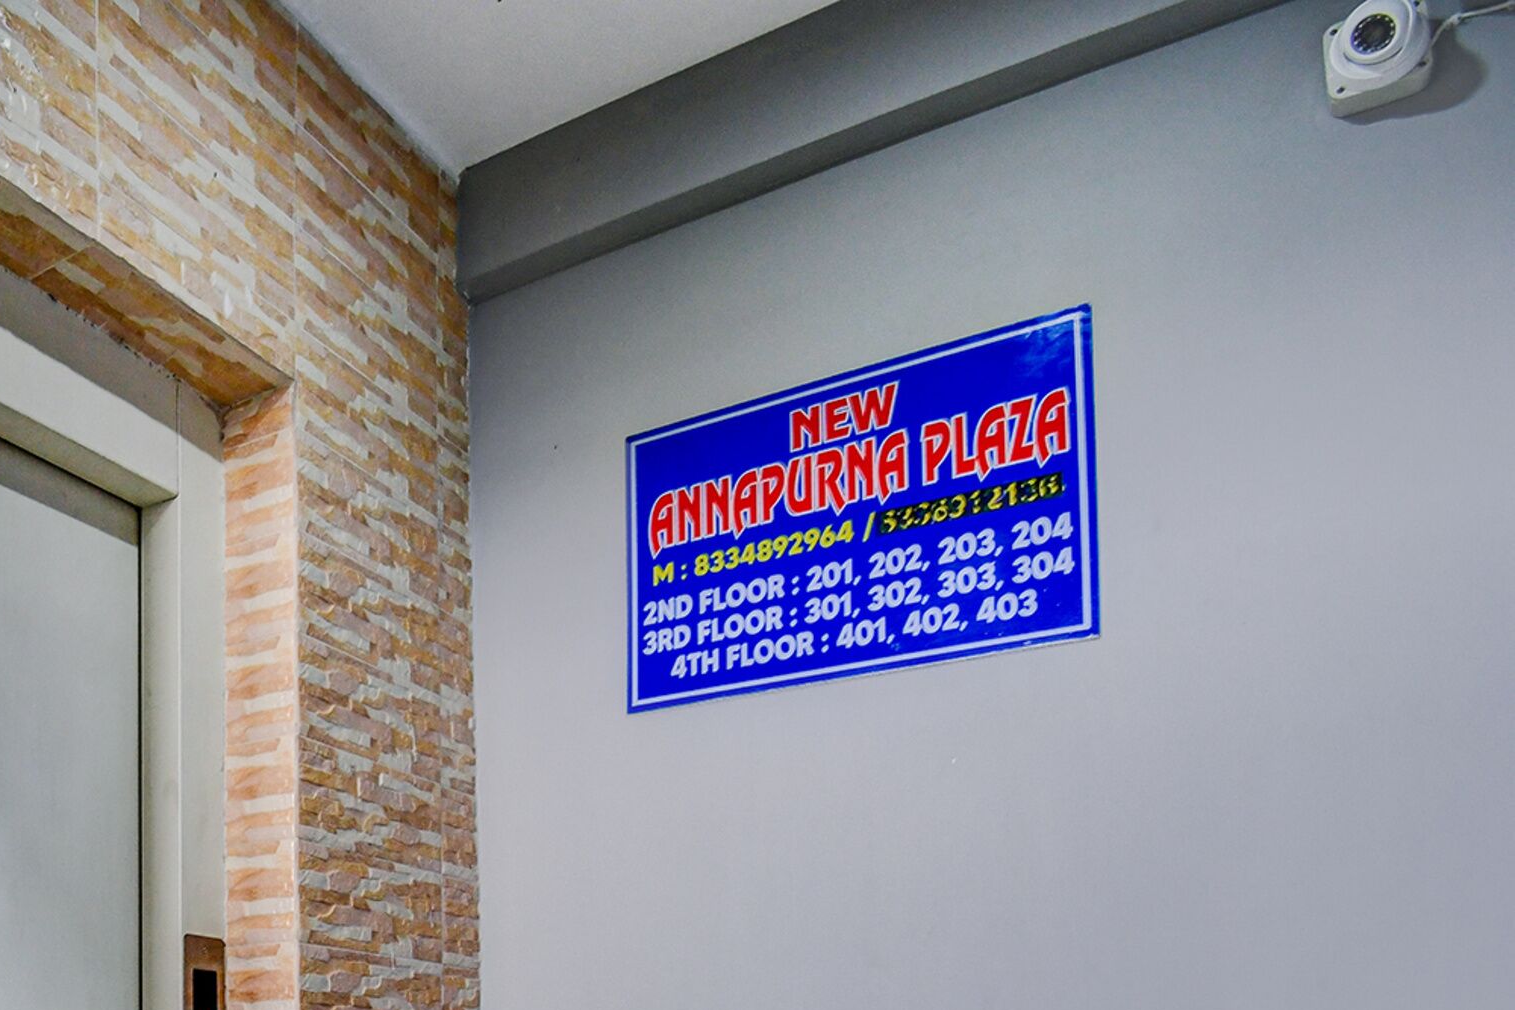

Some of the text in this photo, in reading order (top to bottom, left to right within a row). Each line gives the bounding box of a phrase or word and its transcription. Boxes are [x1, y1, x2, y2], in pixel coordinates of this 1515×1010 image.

[790, 380, 900, 453] NEW
[648, 387, 1071, 558] ANNAPURNA PLAZA
[643, 594, 693, 626] 2ND
[699, 573, 785, 615] FLOOR
[806, 558, 861, 593] 201,
[868, 543, 931, 580] 202,
[937, 528, 1003, 565] 203,
[1011, 511, 1074, 550] 204
[693, 520, 854, 577] 8334892964
[642, 624, 692, 655] 3RD
[697, 605, 784, 645] FLOOR
[804, 590, 861, 624] 301,
[867, 577, 930, 612] 302,
[937, 561, 1004, 598] 303,
[1011, 546, 1076, 584] 304
[670, 648, 720, 679] 4TH
[726, 631, 815, 670] FLOOR
[836, 616, 896, 649] 401,
[902, 603, 969, 637] 402,
[976, 588, 1039, 624] 403
